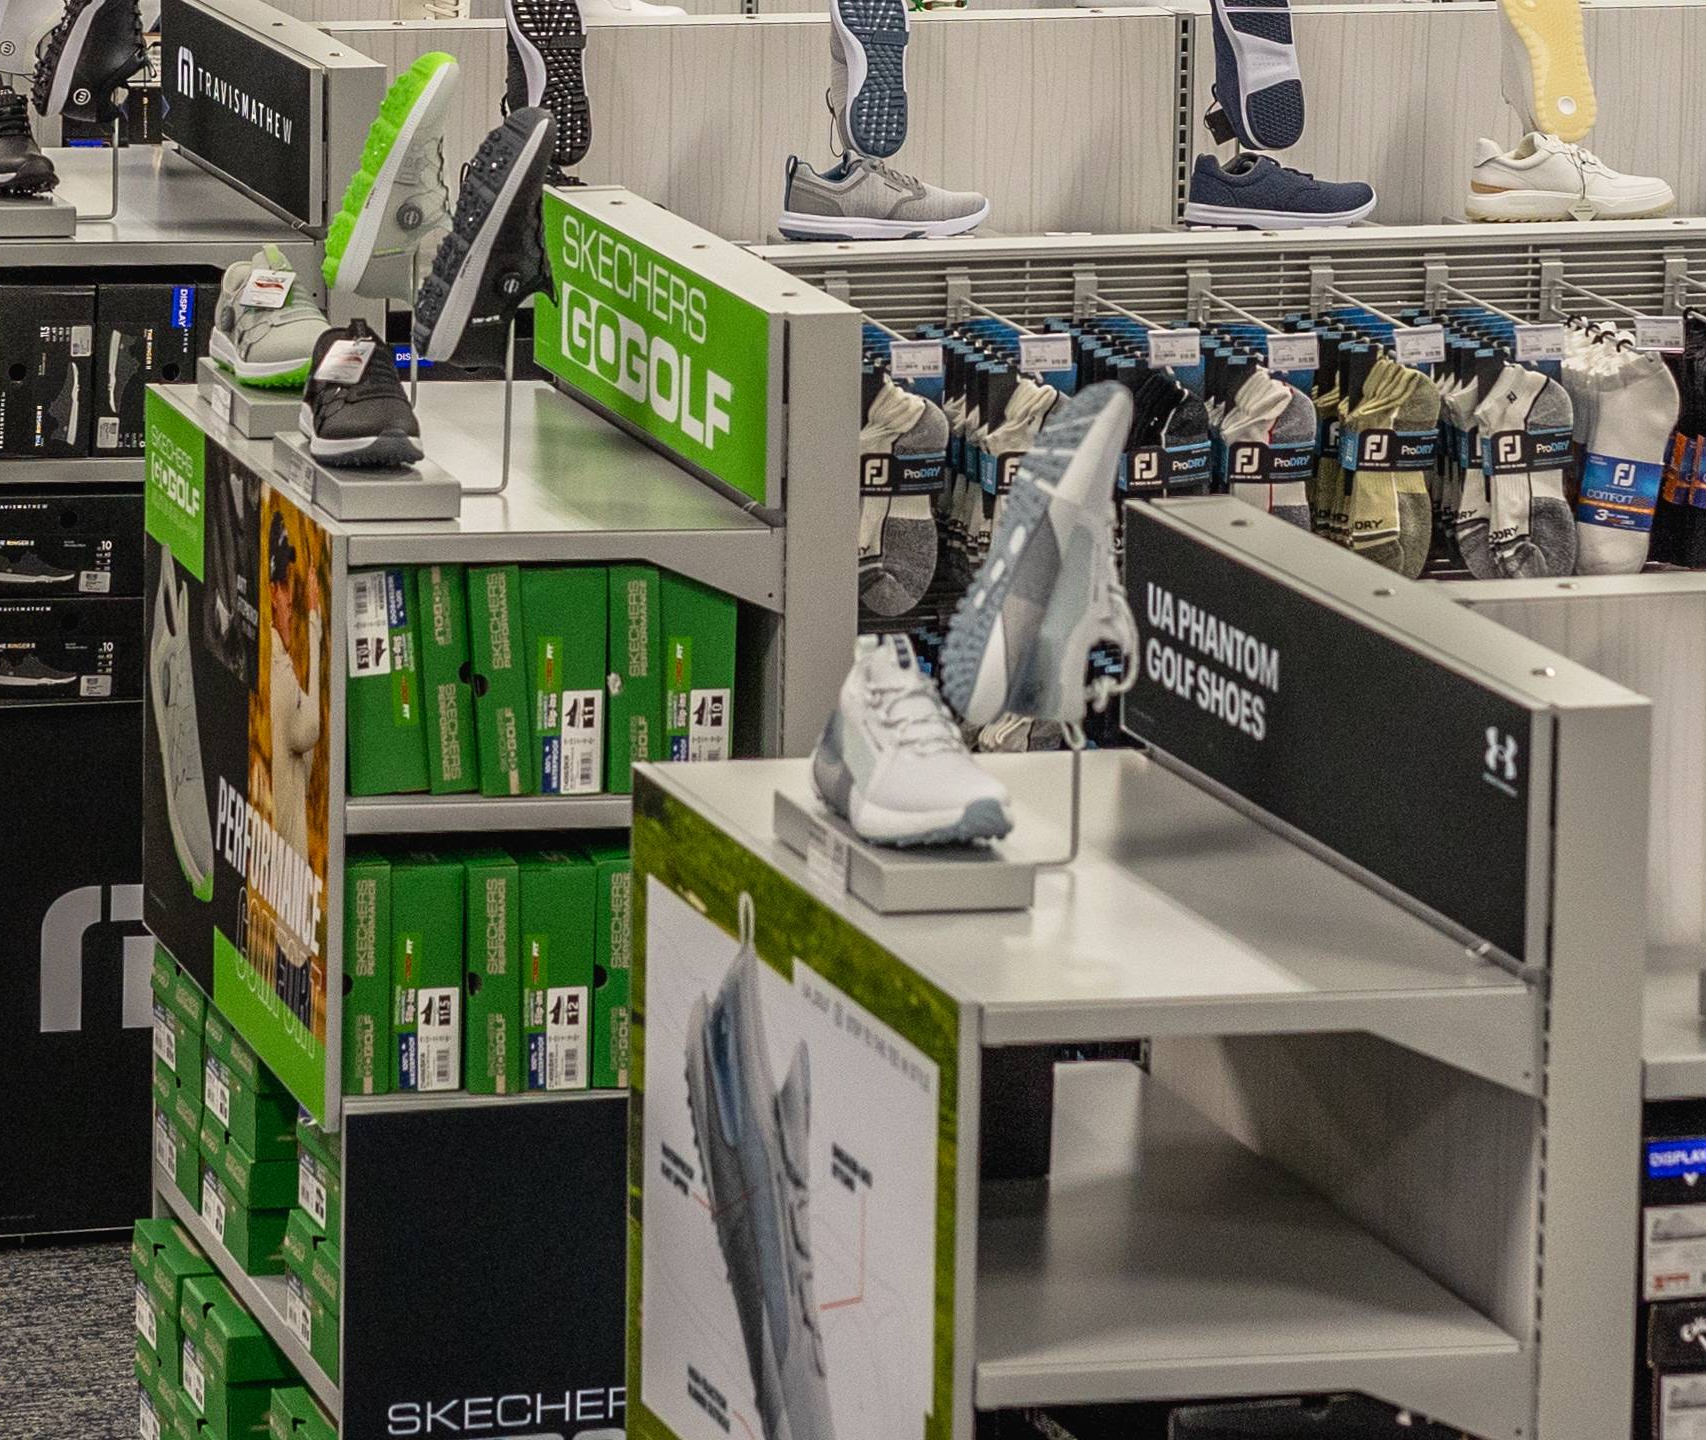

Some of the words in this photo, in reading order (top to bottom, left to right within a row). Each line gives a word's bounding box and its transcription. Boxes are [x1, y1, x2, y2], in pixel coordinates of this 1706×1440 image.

[197, 66, 293, 145] TRAVISMATHEW
[561, 215, 708, 345] SKECHERS
[178, 288, 188, 327] DISPLAY
[1363, 433, 1389, 460] FJ
[1400, 444, 1433, 457] ProDRY
[1498, 435, 1522, 463] FJ
[1535, 439, 1569, 454] ProDRY
[864, 459, 889, 485] FJ
[903, 466, 941, 479] ProDRY
[1134, 452, 1158, 480] FJ
[1172, 454, 1207, 471] ProDRY
[1235, 447, 1260, 474] FJ
[1273, 454, 1310, 468] ProDRY
[1614, 463, 1636, 487] FJ
[1594, 509, 1608, 521] 3
[6, 539, 30, 547] RINGER
[101, 539, 112, 551] 10
[487, 573, 501, 670] SKECHERS
[628, 579, 639, 677] SKECHERS
[7, 642, 30, 650] RINGER
[102, 641, 113, 652] 10
[1147, 582, 1180, 638] UA
[1178, 601, 1279, 693] PHANTOM
[1146, 635, 1193, 703] GOLF
[1196, 663, 1266, 742] SHOES
[218, 773, 323, 958] PERFORMANCE
[355, 879, 366, 976] SKECHERS
[486, 879, 497, 974] SKECHERS
[387, 1386, 627, 1436] SKECHER
